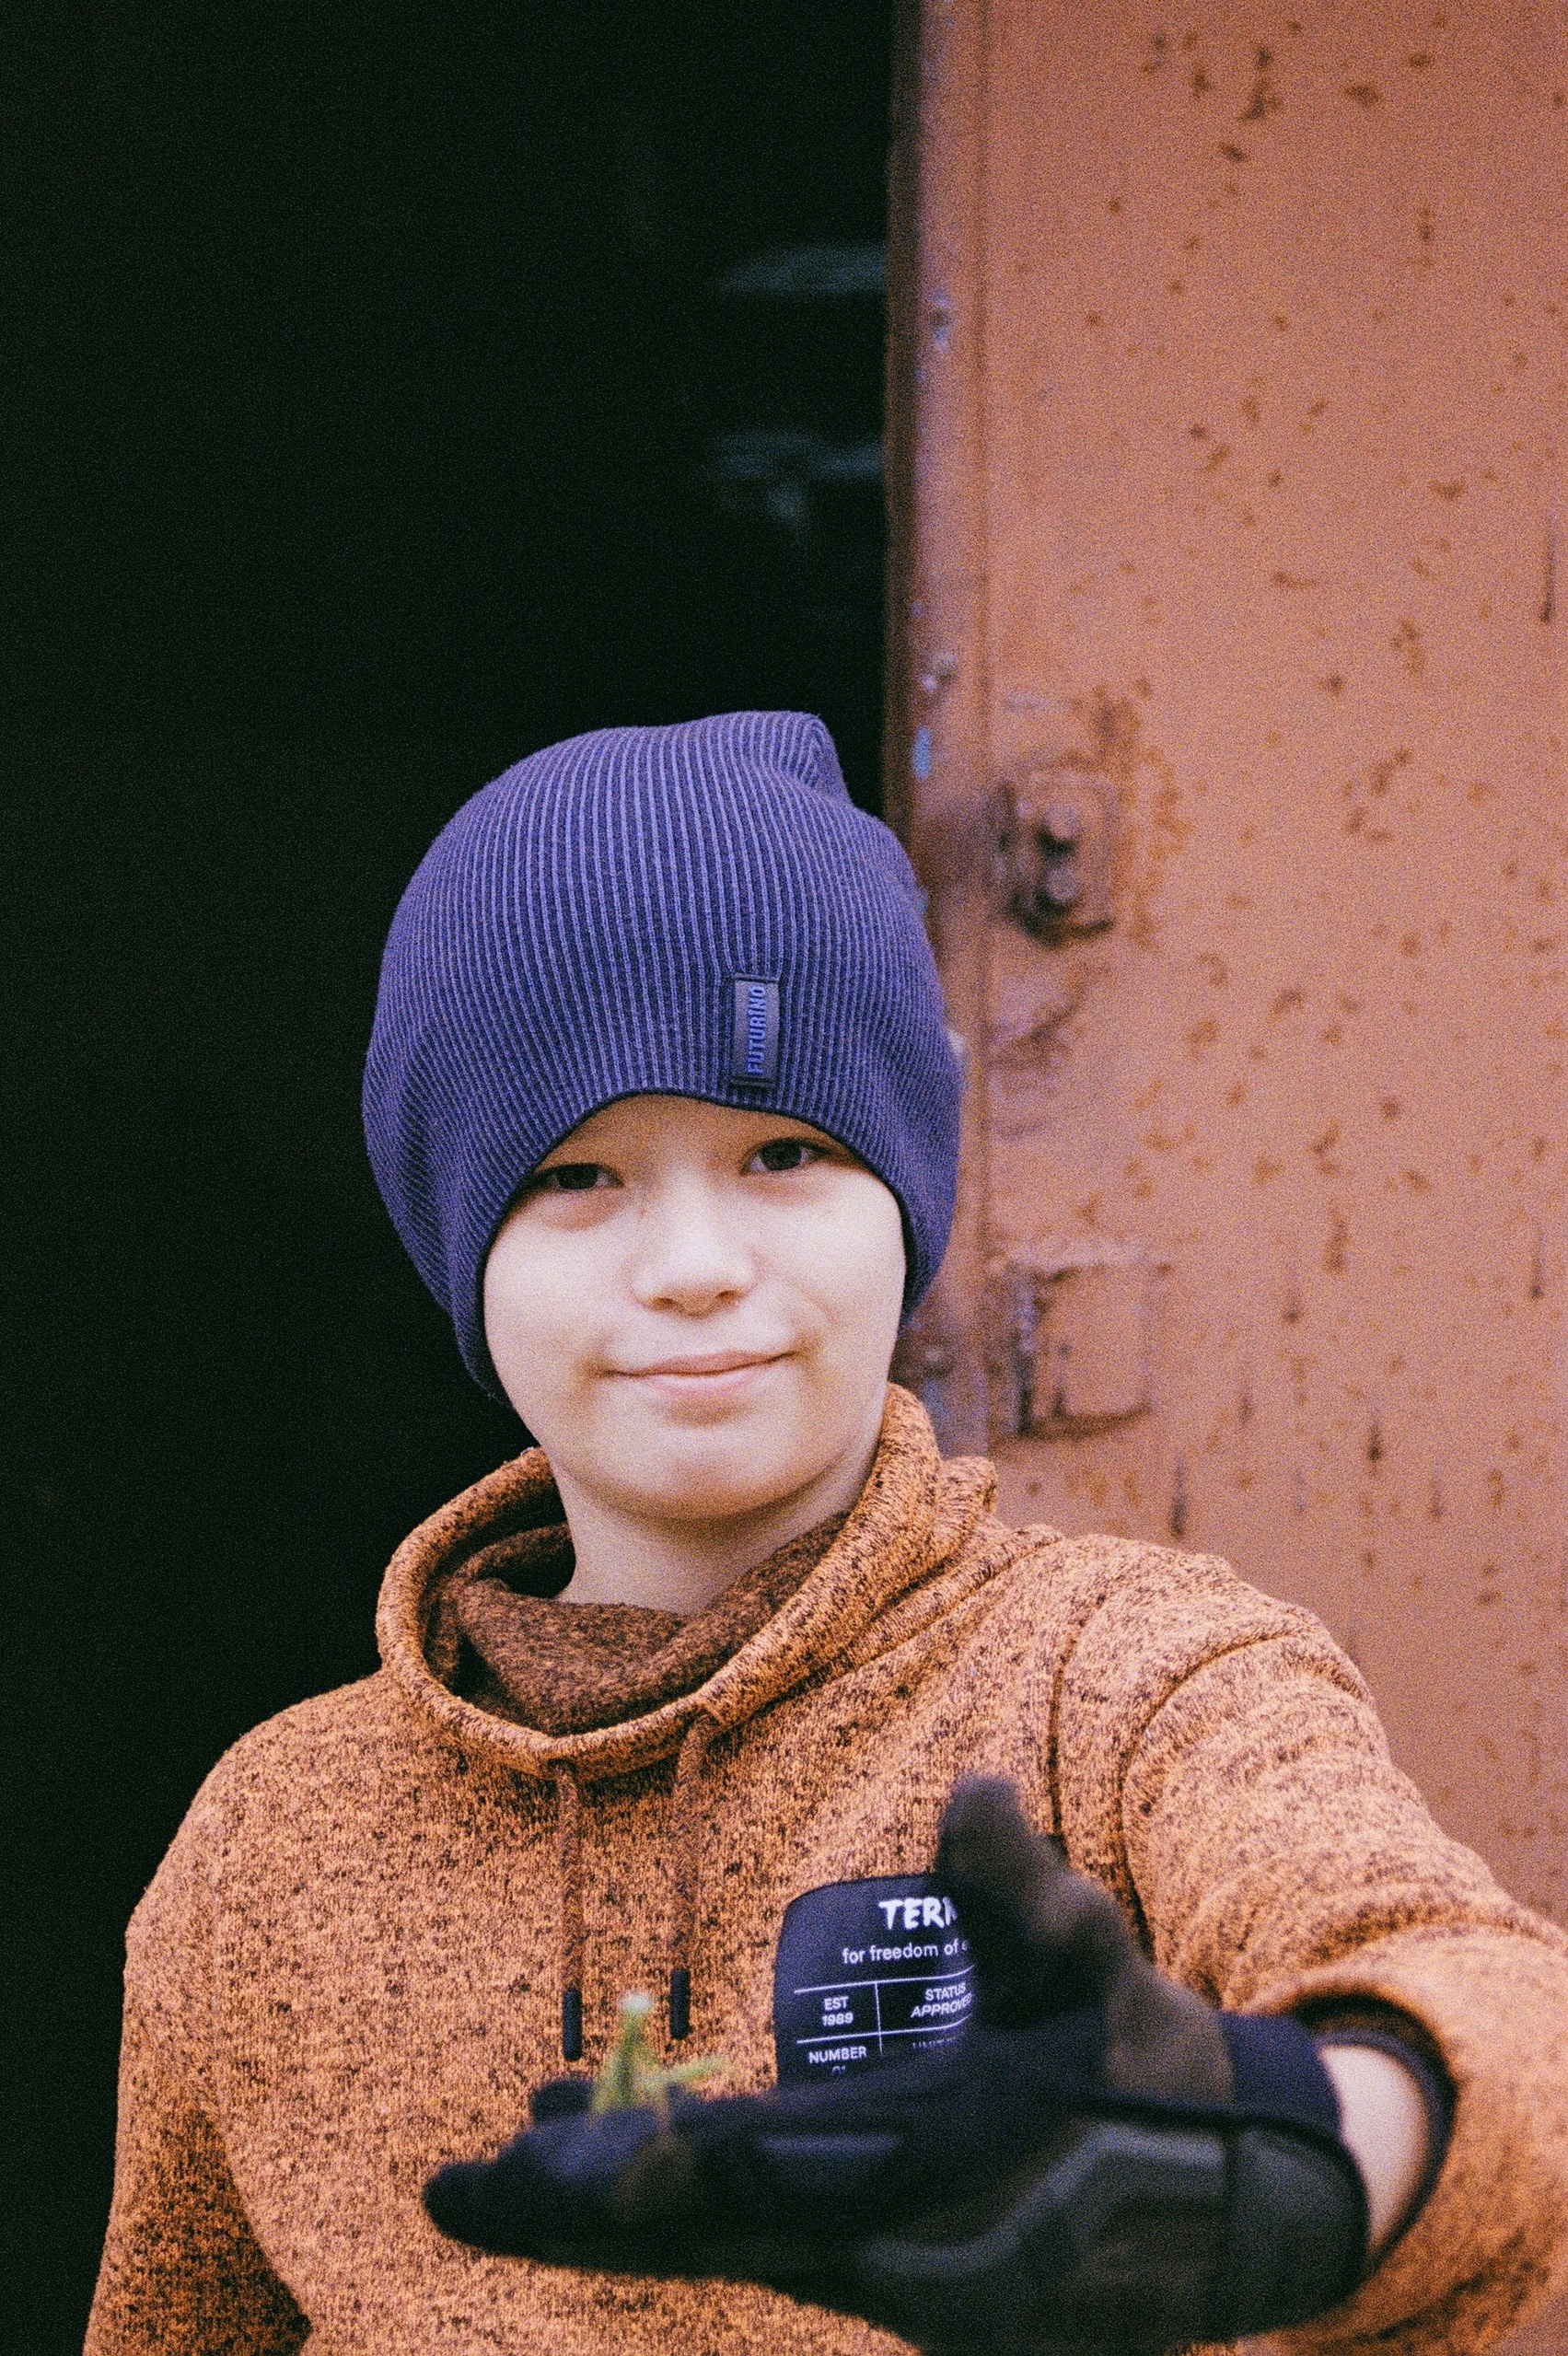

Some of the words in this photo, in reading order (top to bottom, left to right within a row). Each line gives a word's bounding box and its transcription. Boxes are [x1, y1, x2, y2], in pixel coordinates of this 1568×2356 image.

[842, 1947, 865, 1964] for
[870, 1943, 938, 1962] freedom
[944, 1938, 958, 1956] of
[924, 1982, 966, 2002] STATUS
[824, 1996, 849, 2011] EST
[822, 2012, 854, 2026] 1989
[808, 2046, 867, 2063] NUMBER
